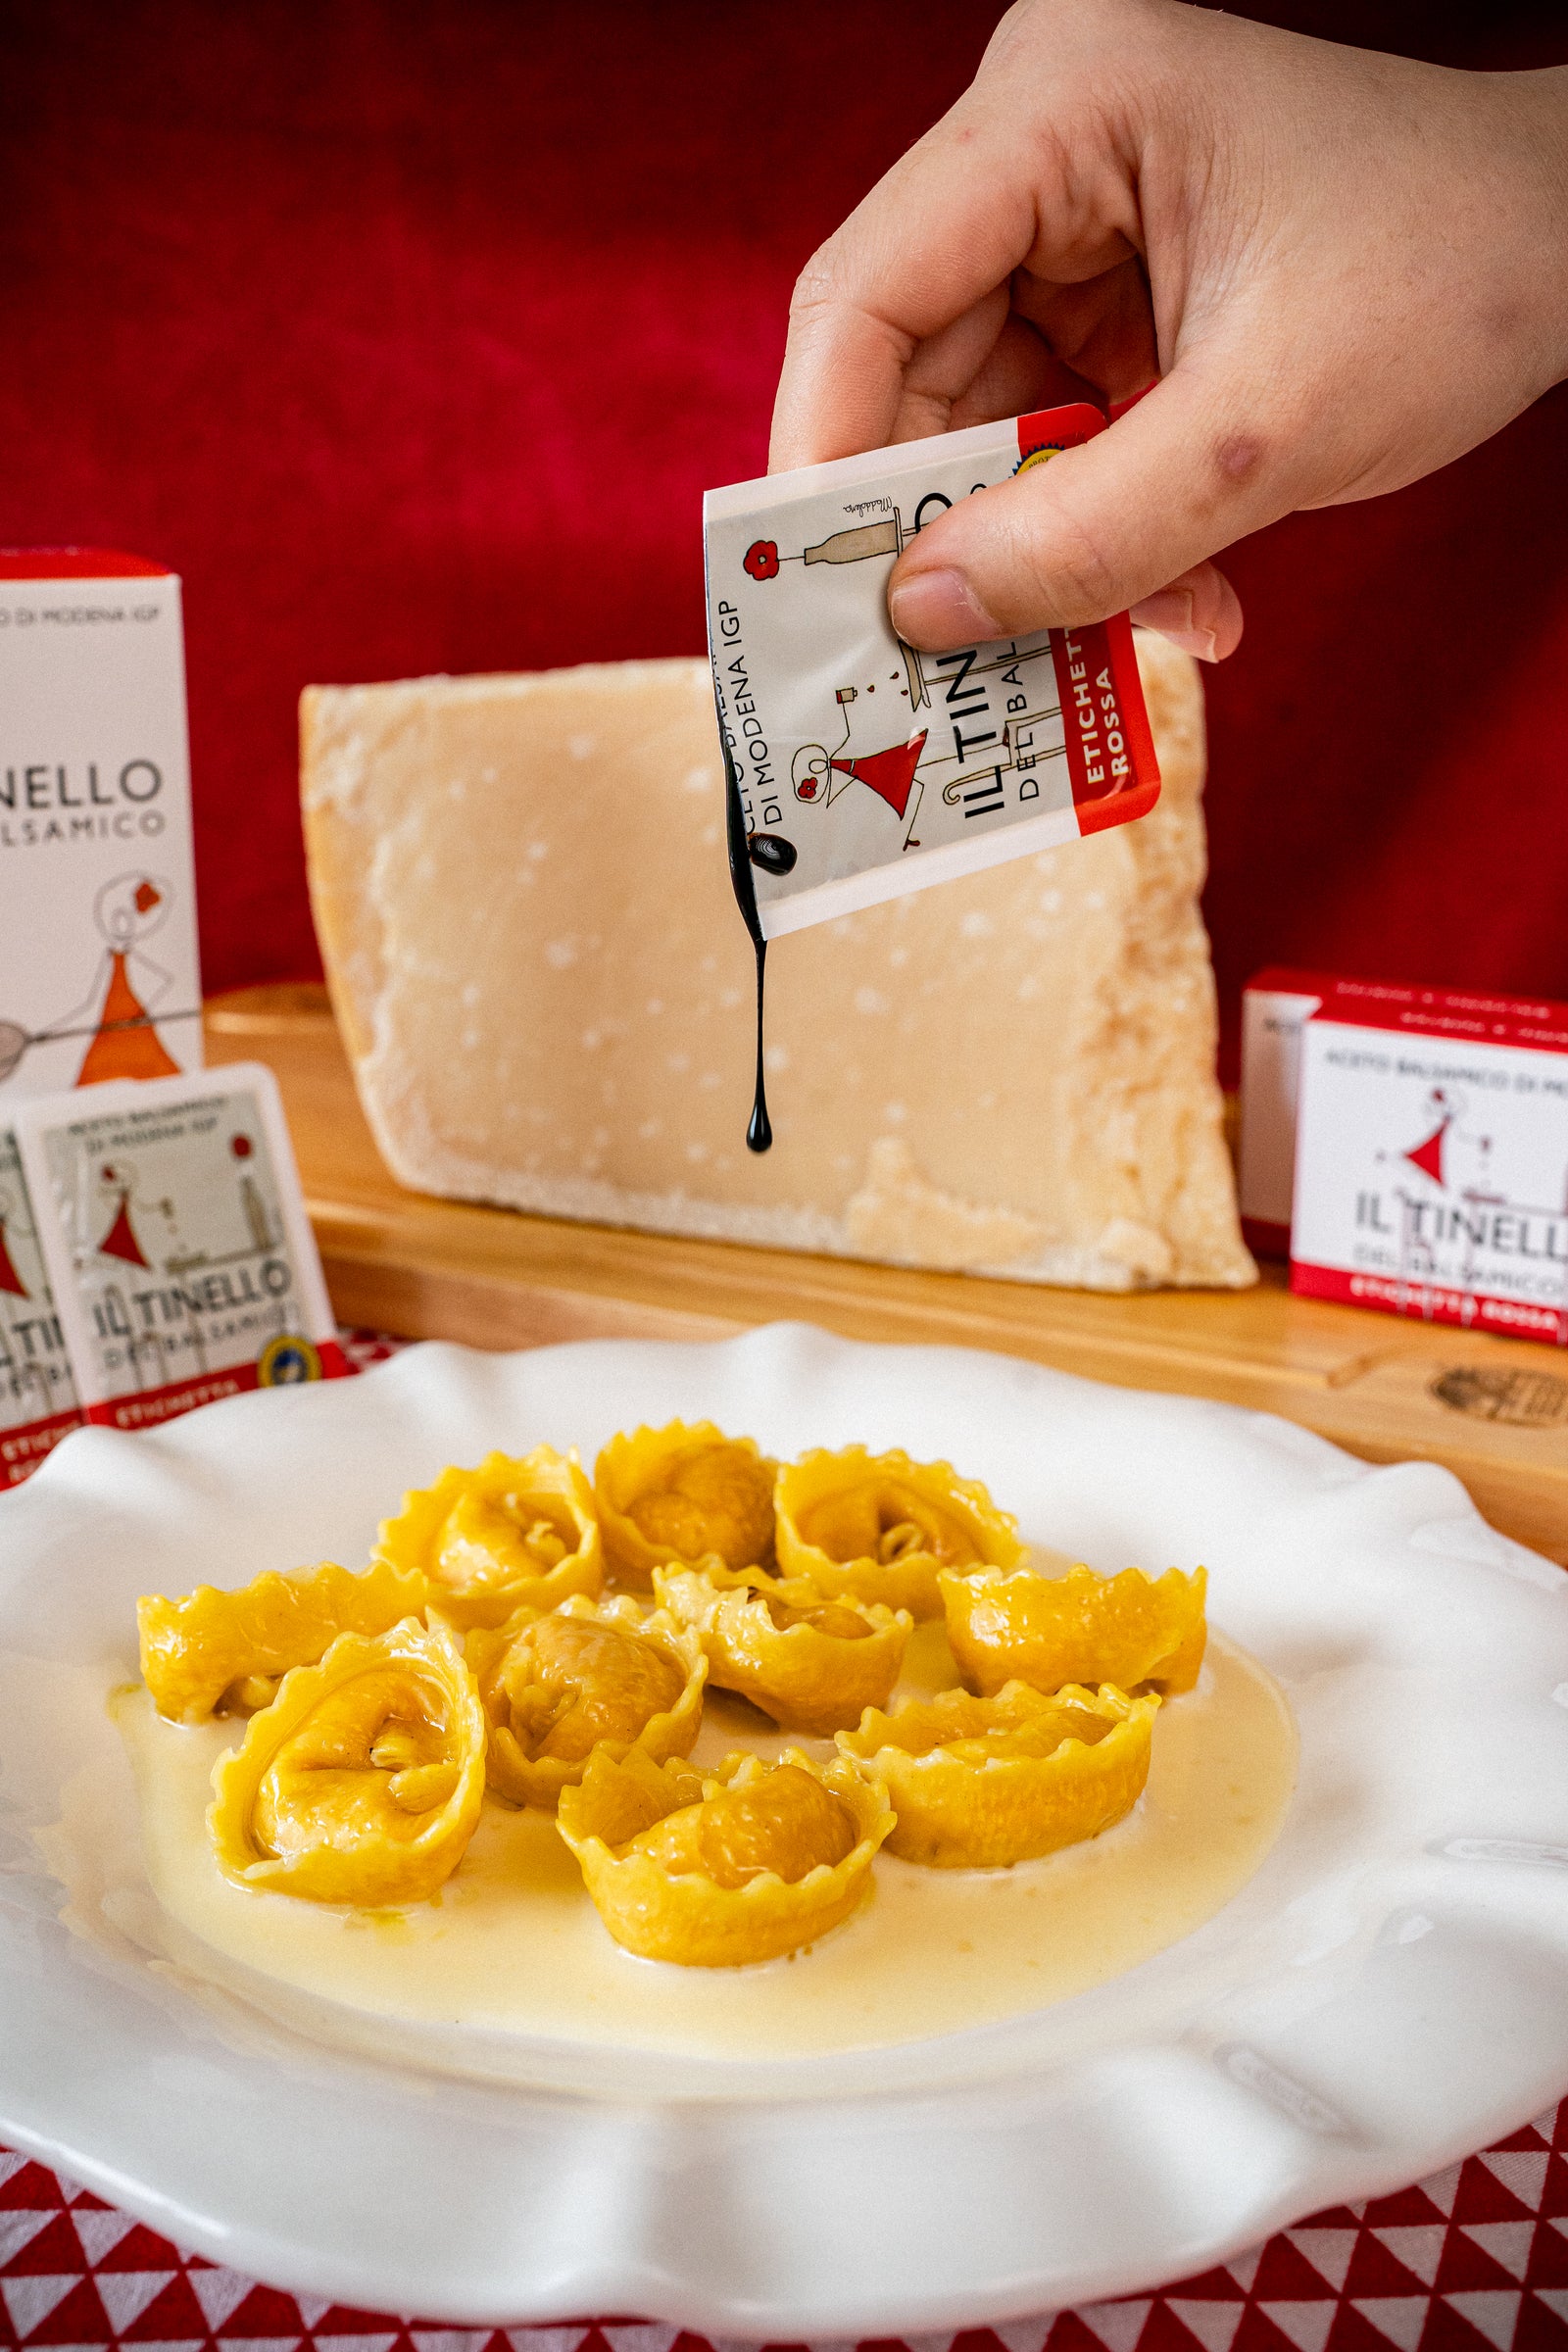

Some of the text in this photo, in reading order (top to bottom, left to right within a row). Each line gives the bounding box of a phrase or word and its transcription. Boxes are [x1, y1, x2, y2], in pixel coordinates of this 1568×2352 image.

[718, 600, 742, 647] IGP
[727, 655, 775, 786] MODENA
[1064, 626, 1104, 784] ETICHETT
[1096, 667, 1130, 777] ROSSA
[964, 765, 1005, 819] IL
[1015, 732, 1040, 802] DEL
[760, 795, 783, 825] DI
[1356, 1190, 1568, 1264] IL TINELL
[132, 1258, 293, 1327] TINELLO
